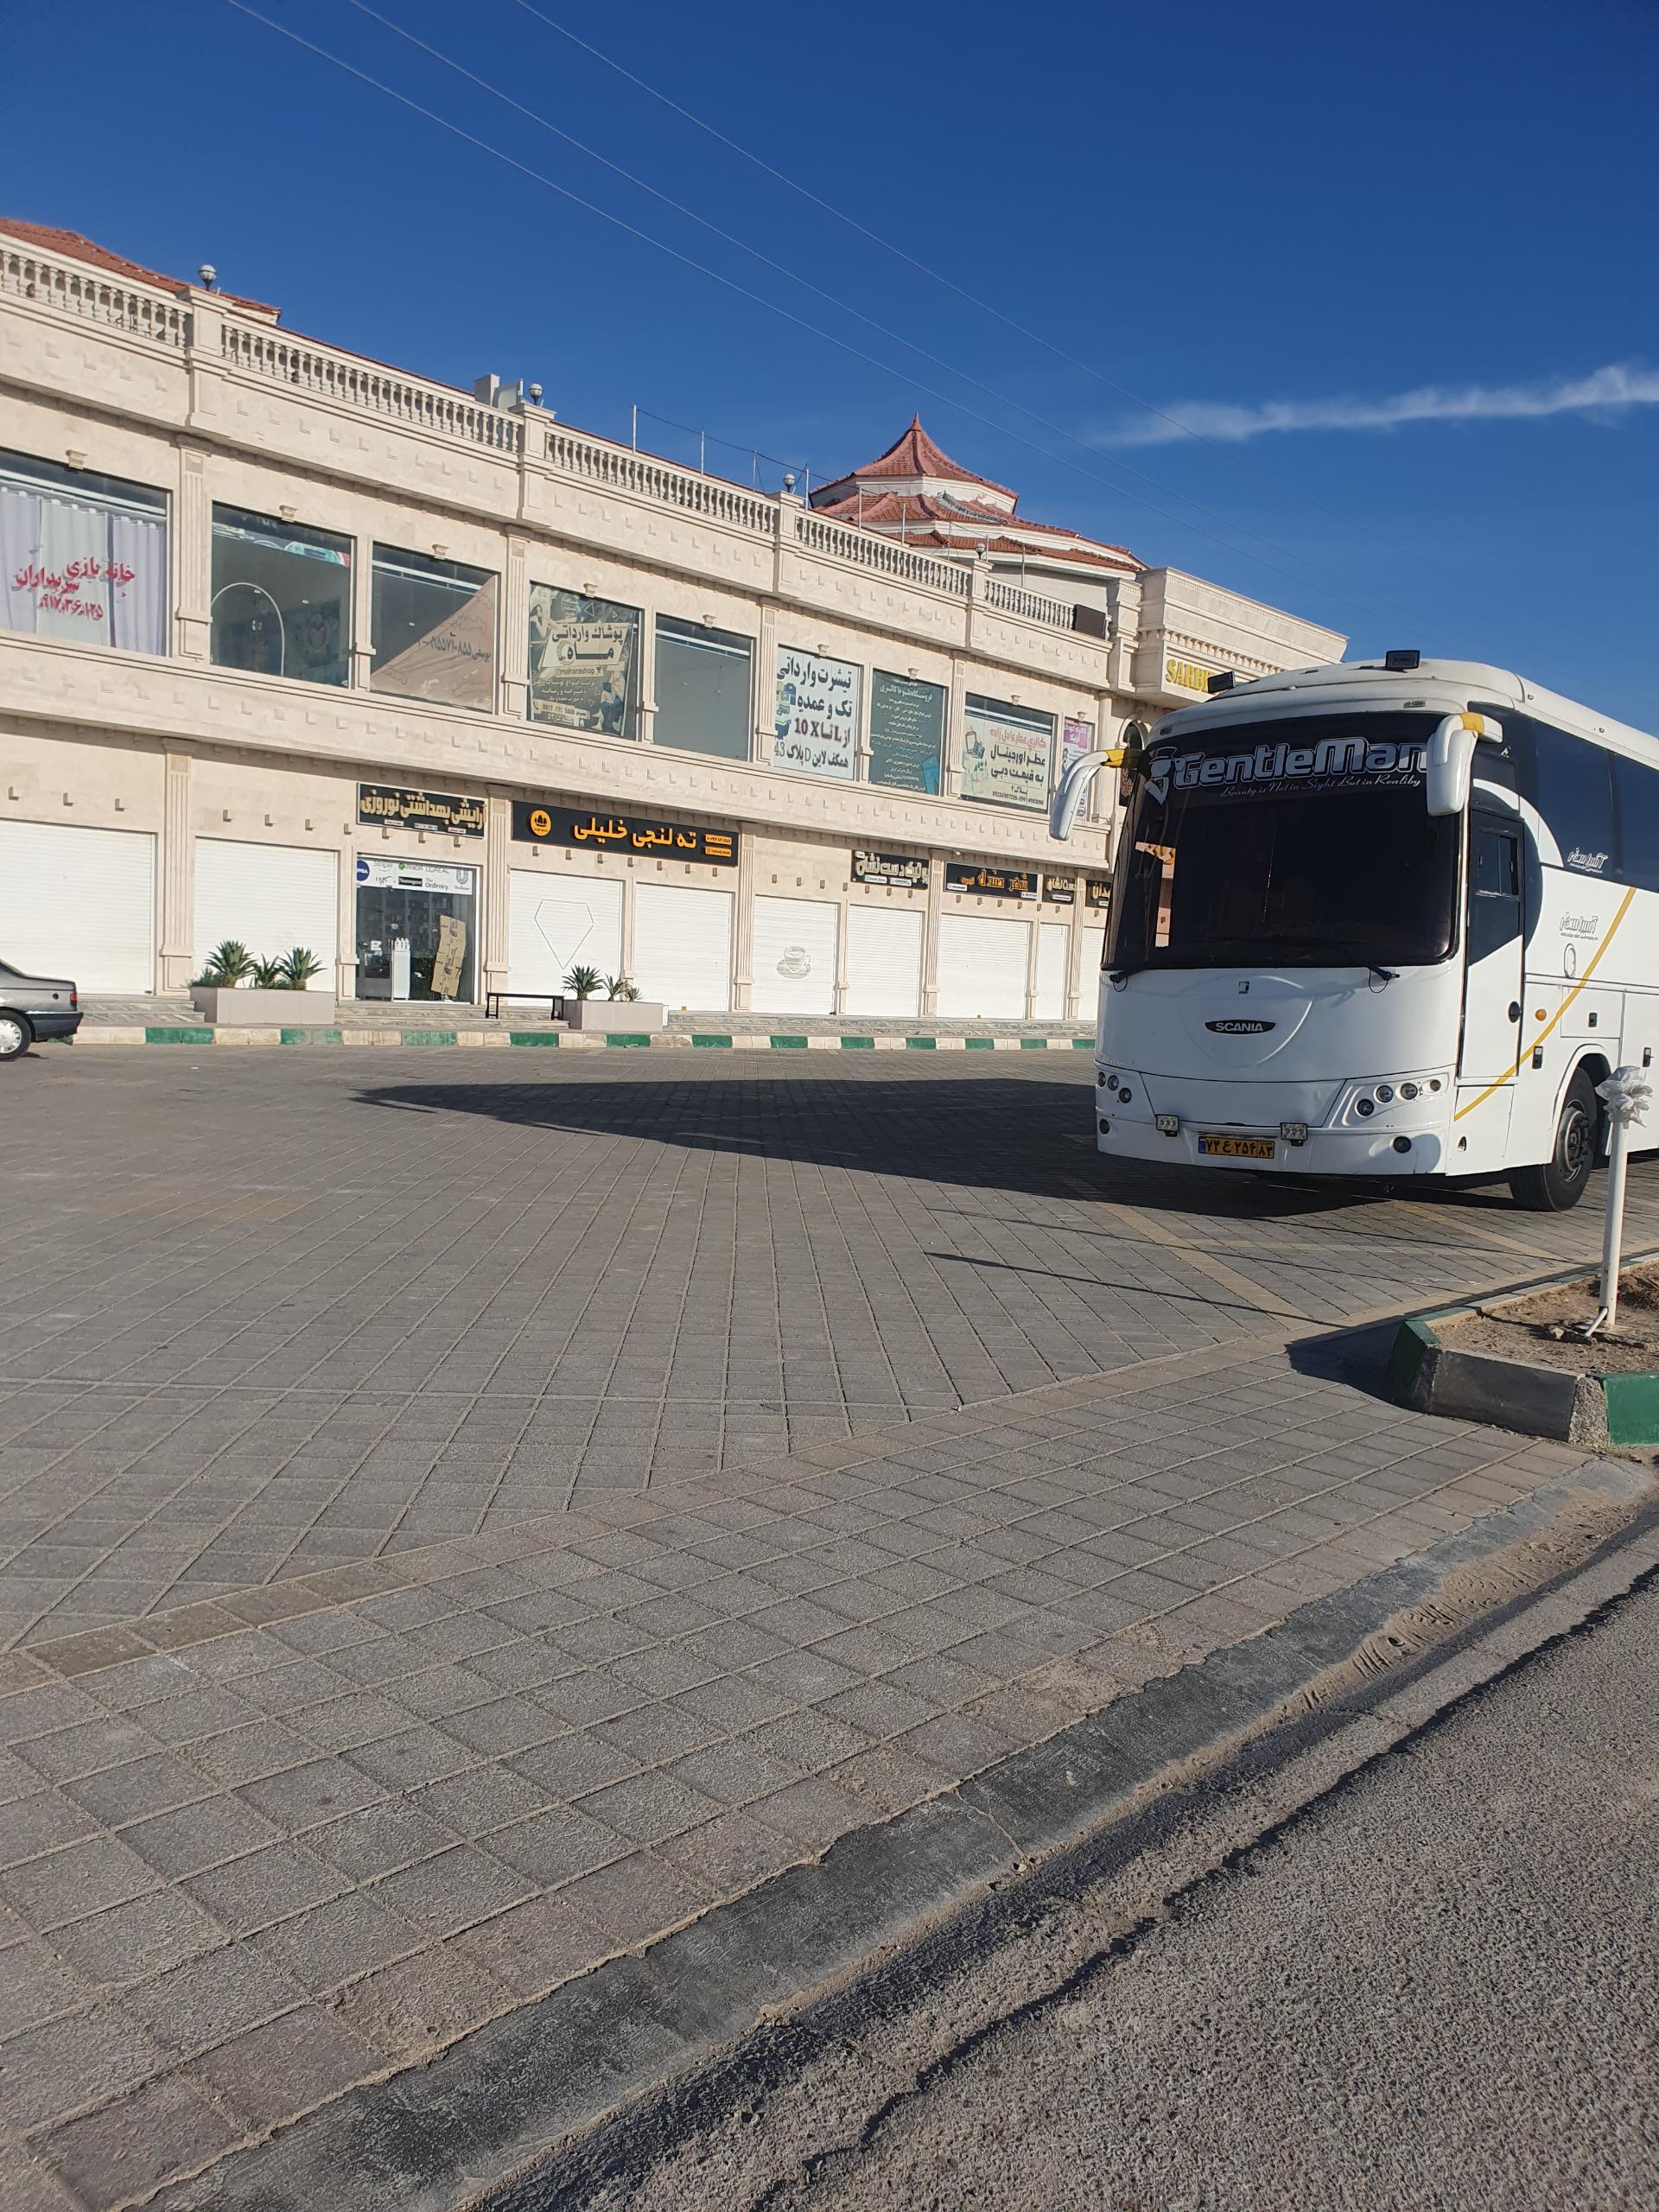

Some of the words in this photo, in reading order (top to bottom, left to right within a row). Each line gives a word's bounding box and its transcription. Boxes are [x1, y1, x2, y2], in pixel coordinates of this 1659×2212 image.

[67, 556, 101, 579] بازی
[105, 563, 136, 582] خانه
[552, 624, 589, 642] وارداتی
[827, 702, 833, 720] و
[835, 699, 853, 718] تک
[804, 747, 811, 761] D
[1026, 753, 1046, 767] عطر
[1175, 737, 1427, 790] GentleMan
[359, 789, 400, 817] نوروزی
[400, 791, 451, 825] بهداشتی
[574, 817, 628, 843] خلیلی
[632, 828, 673, 849] لنجی
[1215, 1022, 1263, 1032] SCANIA
